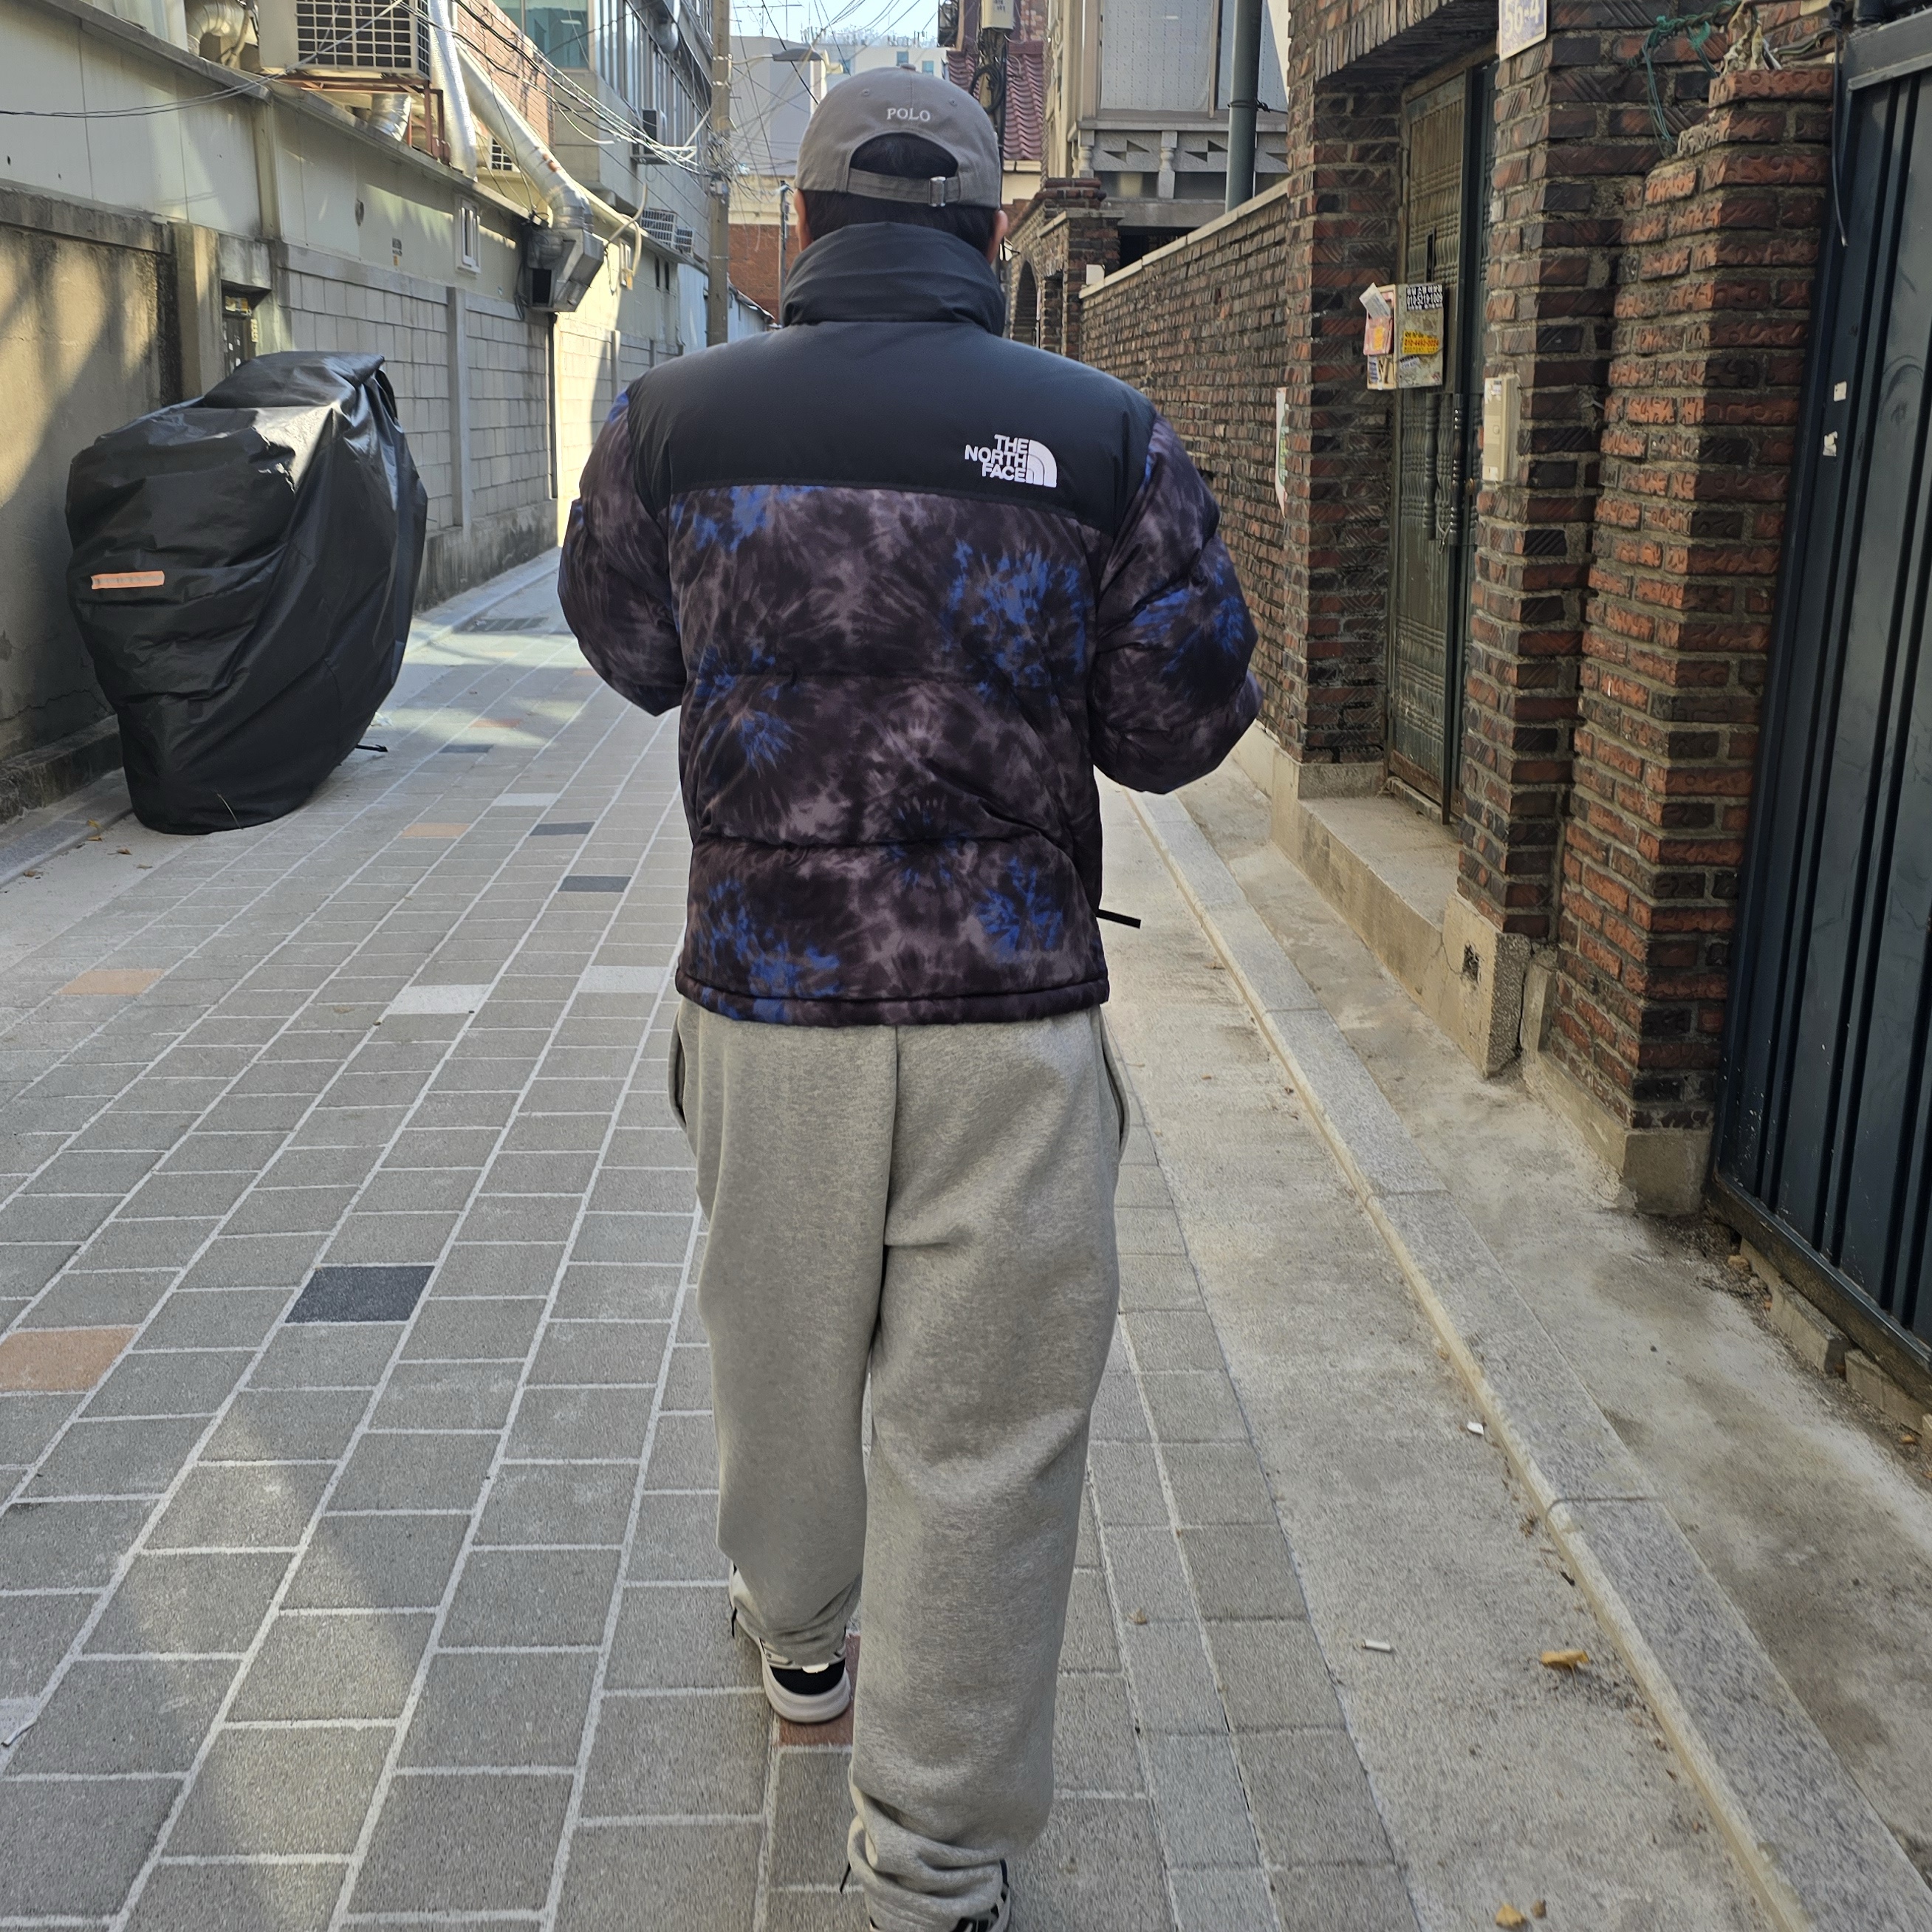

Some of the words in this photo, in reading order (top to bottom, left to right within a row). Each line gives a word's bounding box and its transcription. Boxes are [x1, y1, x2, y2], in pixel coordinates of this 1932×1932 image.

[886, 107, 931, 122] POLO
[994, 434, 1029, 454] THE
[965, 444, 1027, 468] NORTH
[982, 462, 1027, 482] FACE
